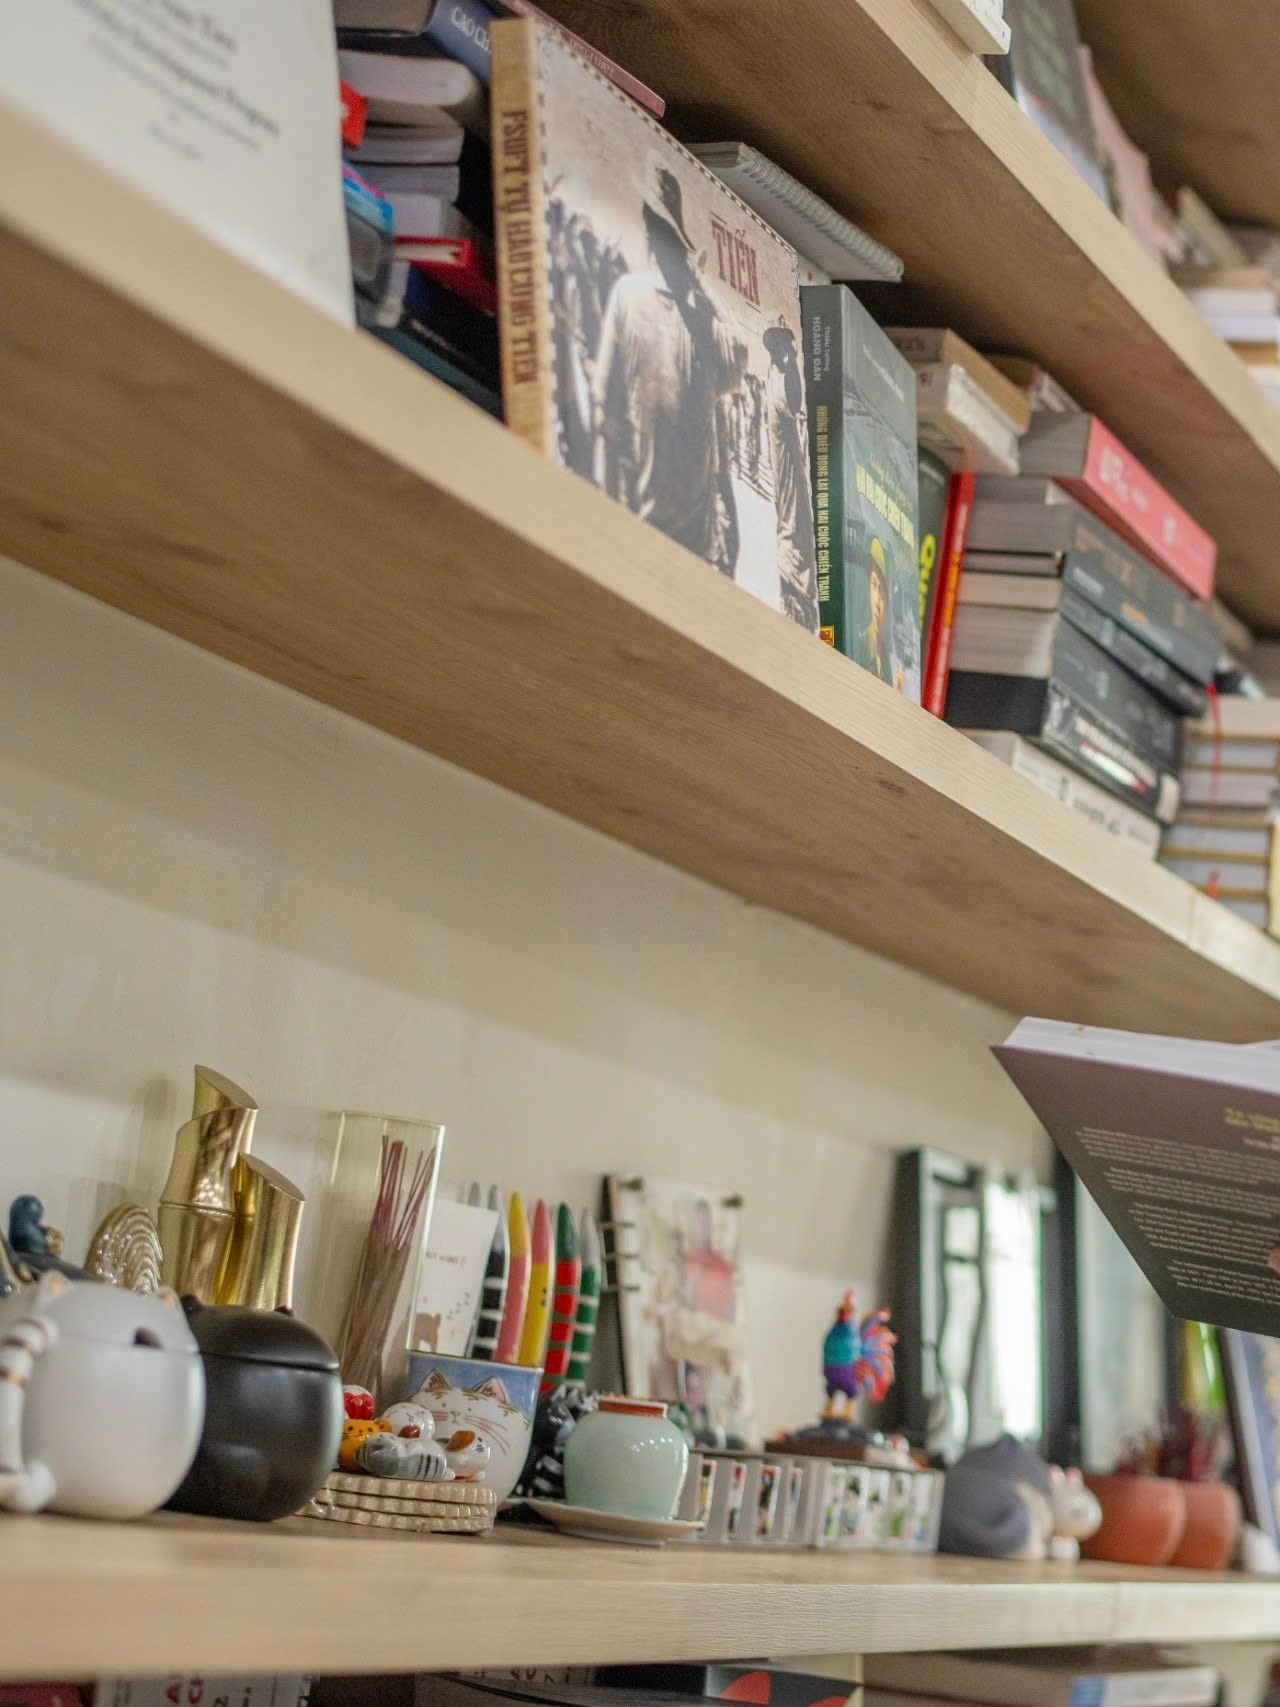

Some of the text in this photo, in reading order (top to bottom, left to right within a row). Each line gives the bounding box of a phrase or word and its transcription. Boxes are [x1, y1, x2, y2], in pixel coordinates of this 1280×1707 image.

[816, 492, 829, 509] QUA
[817, 510, 829, 524] HAI
[816, 525, 831, 548] CUỘC
[817, 549, 832, 574] CHIẾN
[818, 575, 830, 602] TRANH
